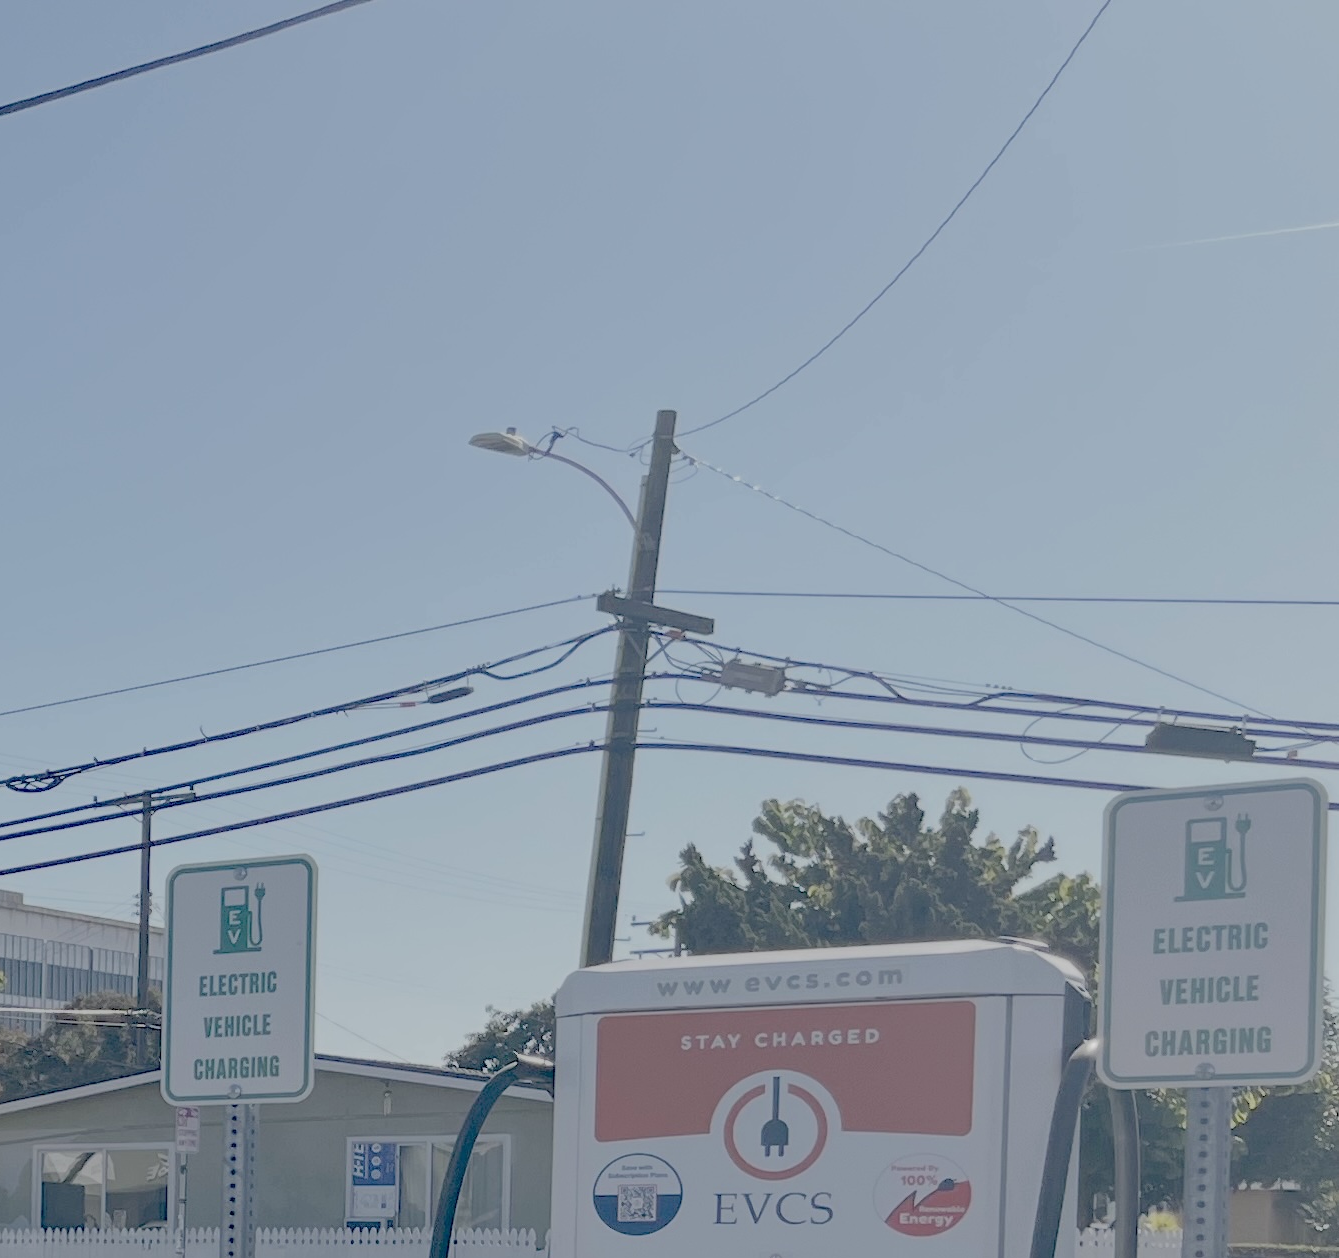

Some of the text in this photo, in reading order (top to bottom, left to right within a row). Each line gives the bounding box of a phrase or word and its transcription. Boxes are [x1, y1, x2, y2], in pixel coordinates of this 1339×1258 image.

[1153, 922, 1269, 954] ELECTRIC
[199, 971, 277, 997] ELECTRIC
[1160, 975, 1259, 1005] VEHICLE
[203, 1014, 271, 1038] VEHICLE
[681, 1028, 880, 1051] STAY CHARGED
[1144, 1026, 1272, 1057] CHARGING
[194, 1055, 280, 1080] CHARGING
[901, 1175, 938, 1186] 100%
[713, 1192, 834, 1225] EVCS
[899, 1212, 954, 1228] Energy
